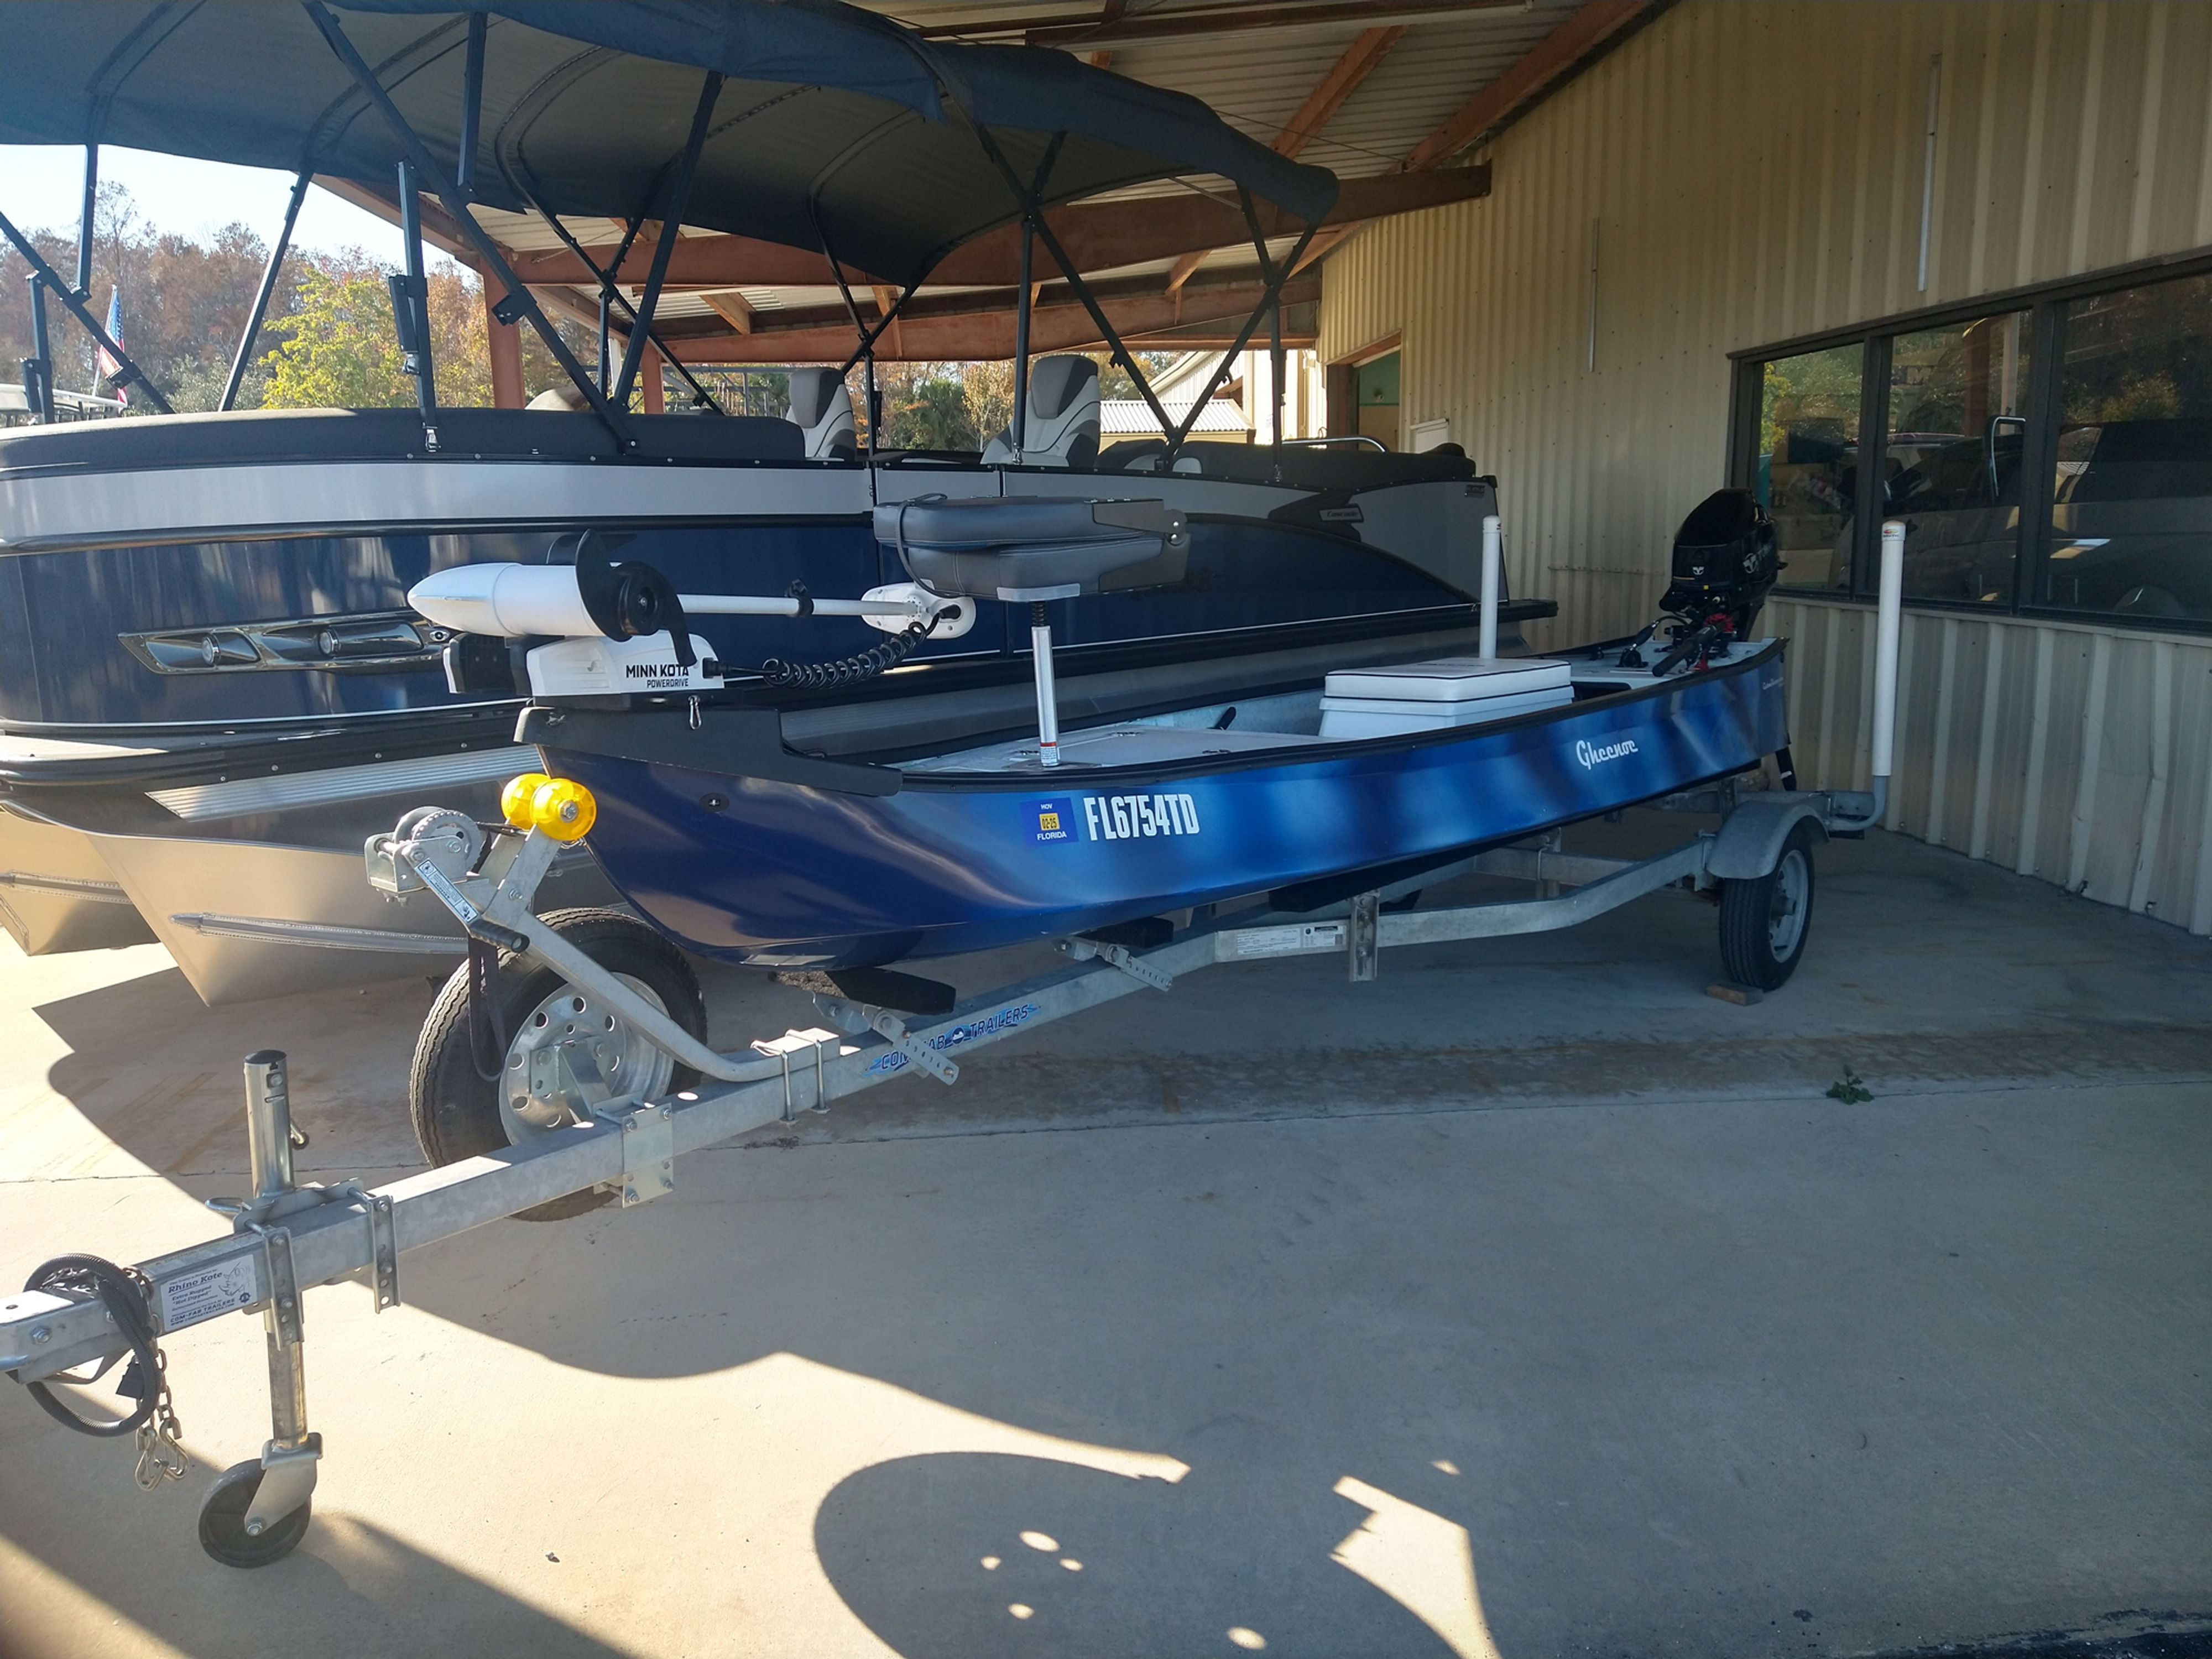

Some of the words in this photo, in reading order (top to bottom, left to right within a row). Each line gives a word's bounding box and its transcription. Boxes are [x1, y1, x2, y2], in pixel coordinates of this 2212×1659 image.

[626, 664, 656, 678] MINN
[660, 664, 688, 677] KOTA
[646, 678, 688, 688] POWERDRIVE
[1576, 739, 1639, 770] Gheenoe
[1083, 793, 1200, 841] FL6754TD
[1037, 831, 1067, 840] FLORIDA
[969, 1004, 1029, 1037] TRAILERS
[168, 1280, 198, 1293] Rhino
[201, 1272, 222, 1283] Kote
[204, 1298, 235, 1312] TRAILERS
